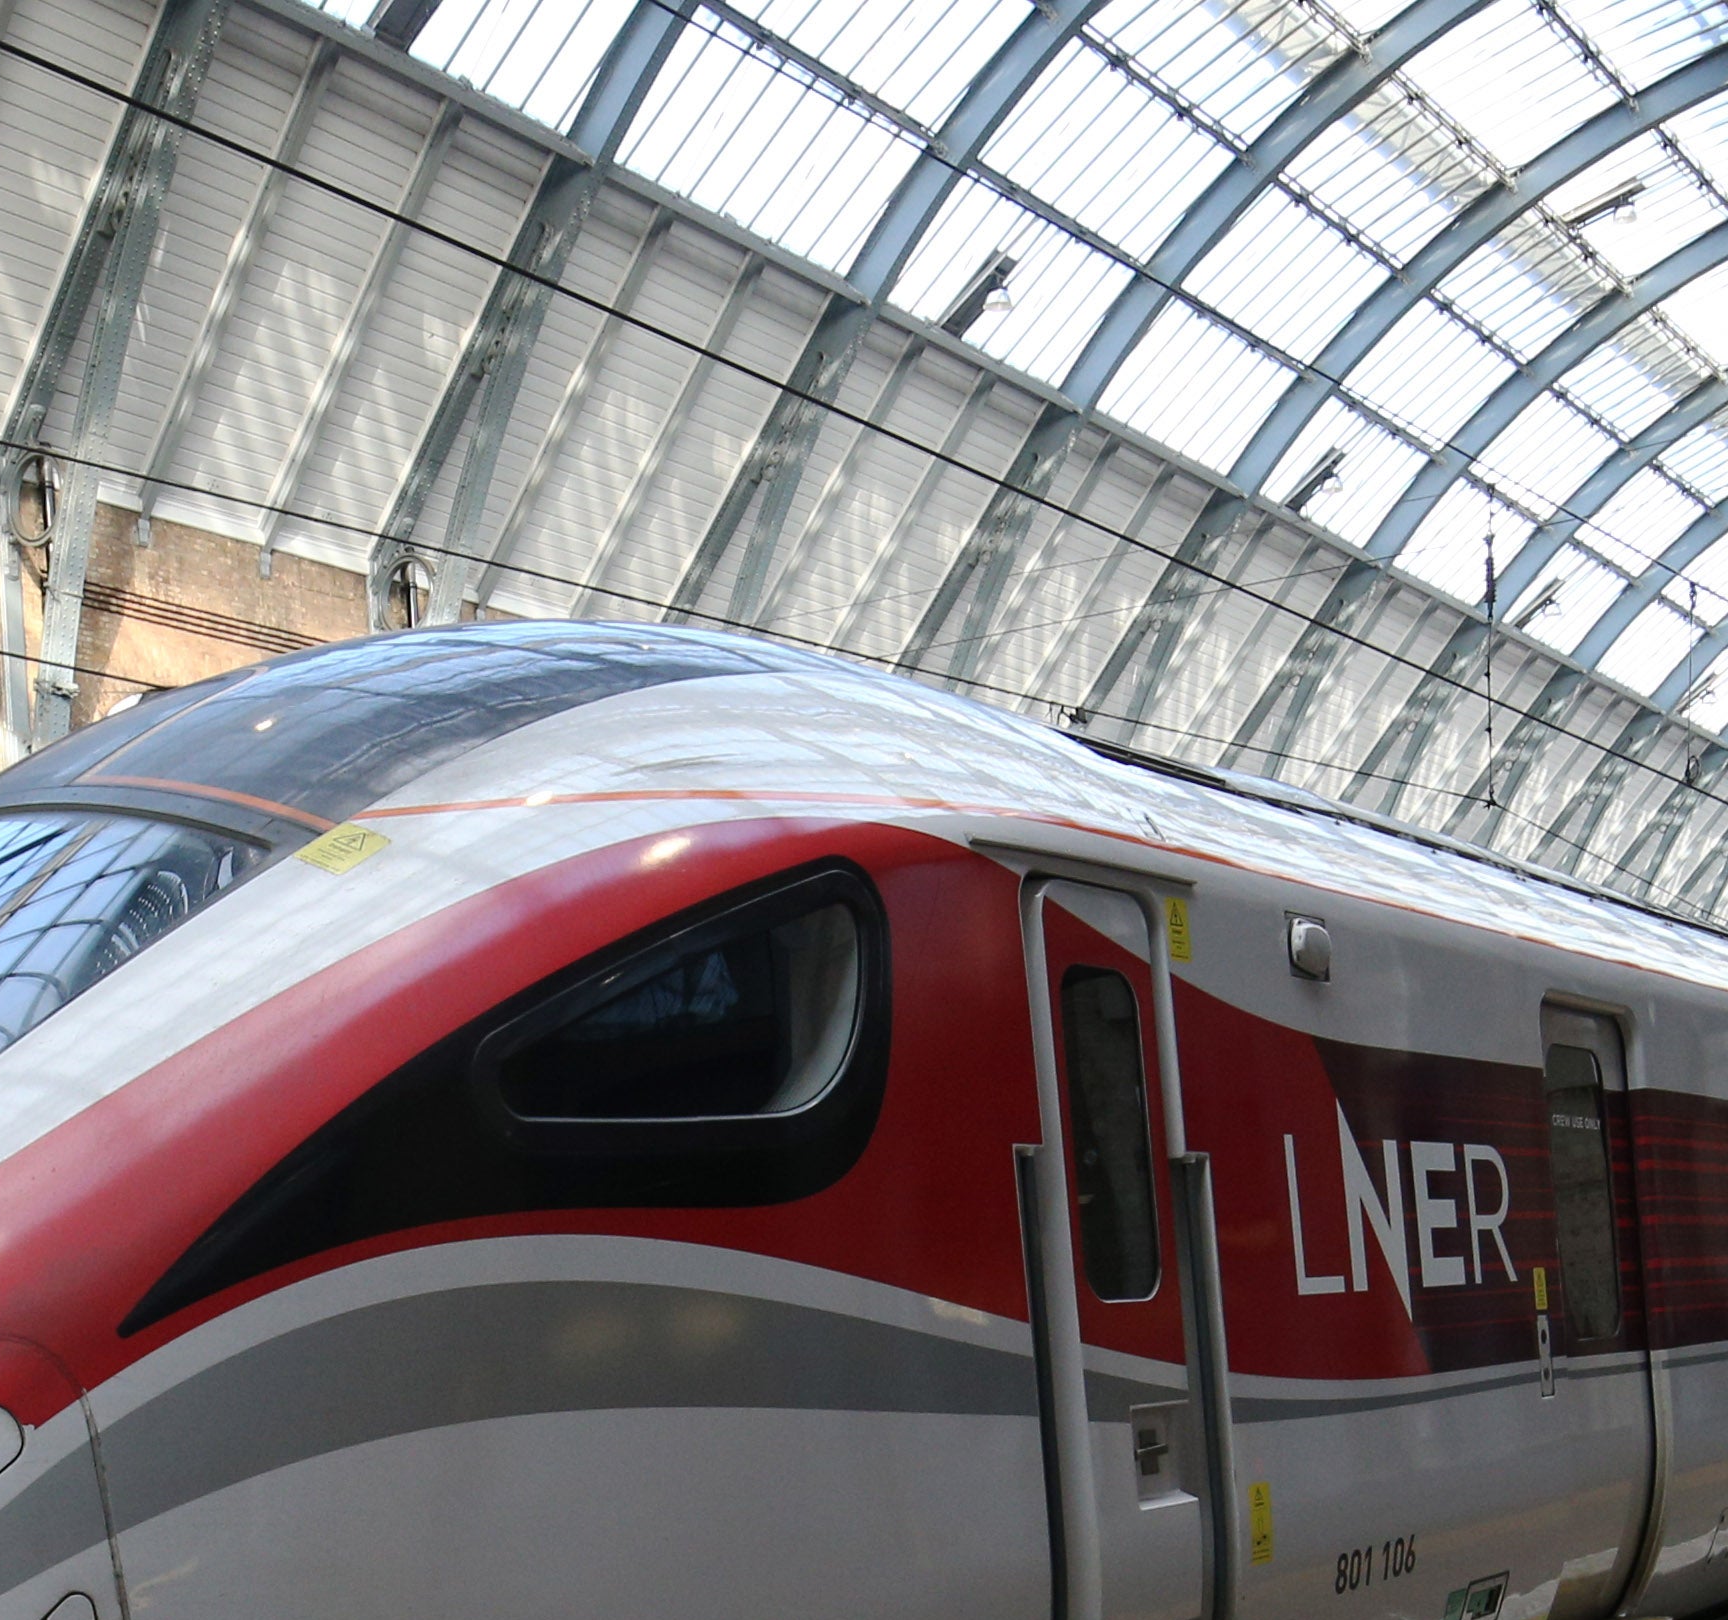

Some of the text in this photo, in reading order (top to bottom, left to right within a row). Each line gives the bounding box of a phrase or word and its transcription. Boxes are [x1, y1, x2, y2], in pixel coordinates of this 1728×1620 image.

[1283, 1098, 1518, 1323] LNER
[1335, 1534, 1416, 1594] 801 106
